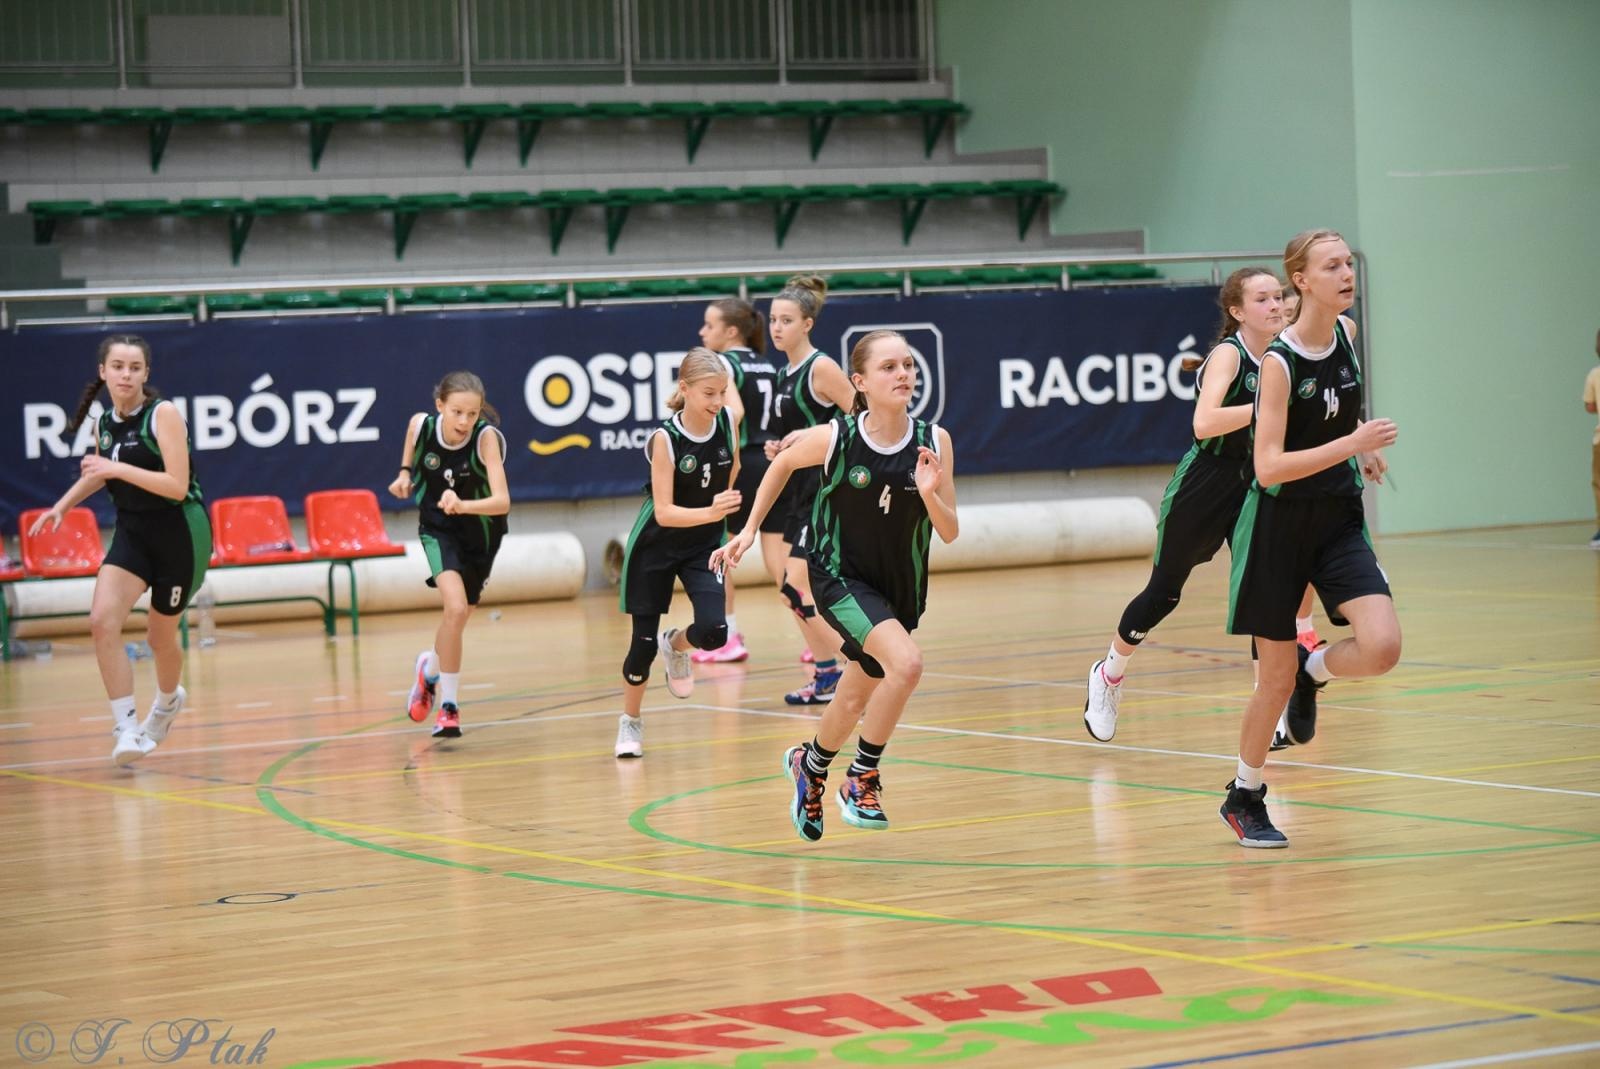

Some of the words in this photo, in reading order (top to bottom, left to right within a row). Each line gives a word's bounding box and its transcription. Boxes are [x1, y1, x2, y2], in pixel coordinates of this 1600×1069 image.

[24, 373, 380, 459] RABÓRZ
[756, 379, 773, 430] 7
[701, 463, 712, 488] 3
[879, 484, 892, 515] 4
[170, 586, 182, 607] 8
